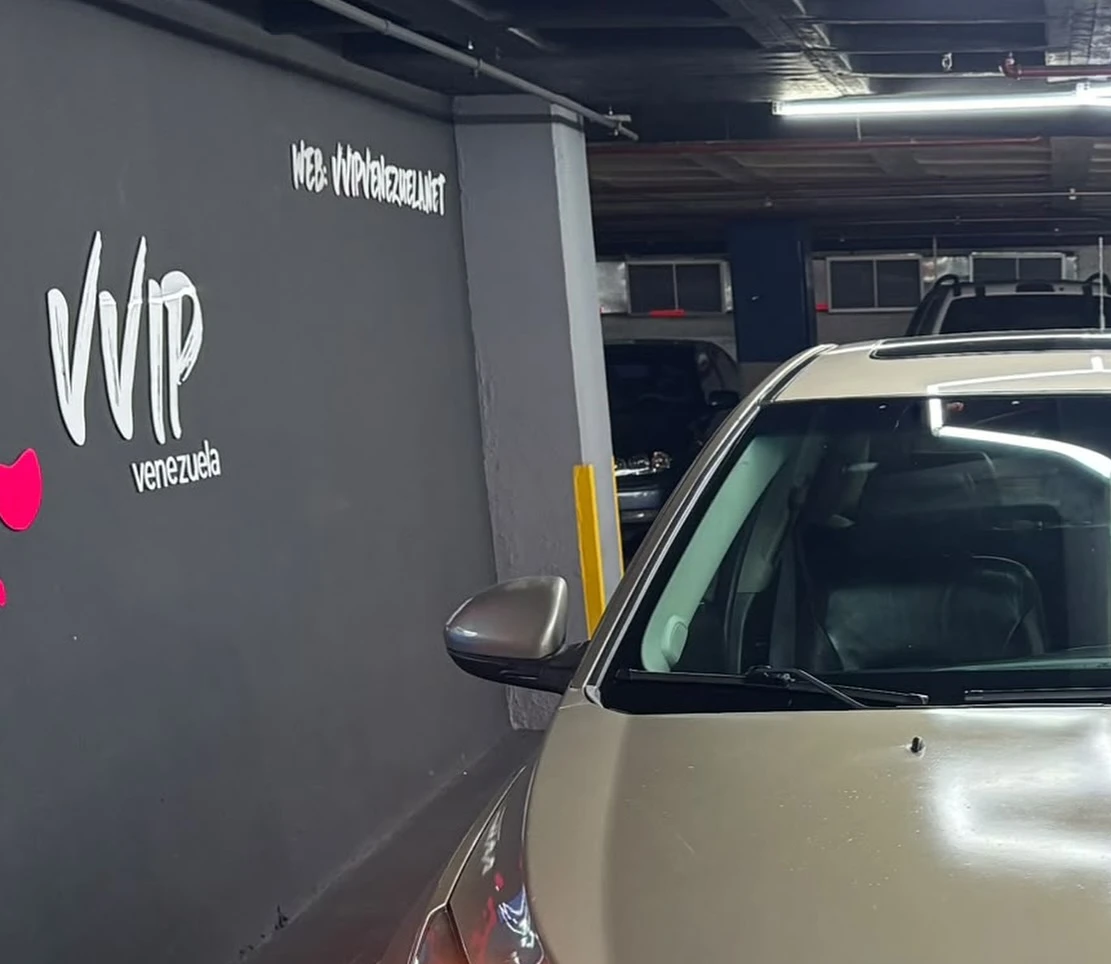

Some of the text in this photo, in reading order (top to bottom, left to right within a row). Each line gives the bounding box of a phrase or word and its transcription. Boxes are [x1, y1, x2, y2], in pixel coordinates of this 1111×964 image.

[291, 139, 328, 193] WEB:
[47, 230, 204, 446] VVIP
[132, 440, 221, 492] venezuela
